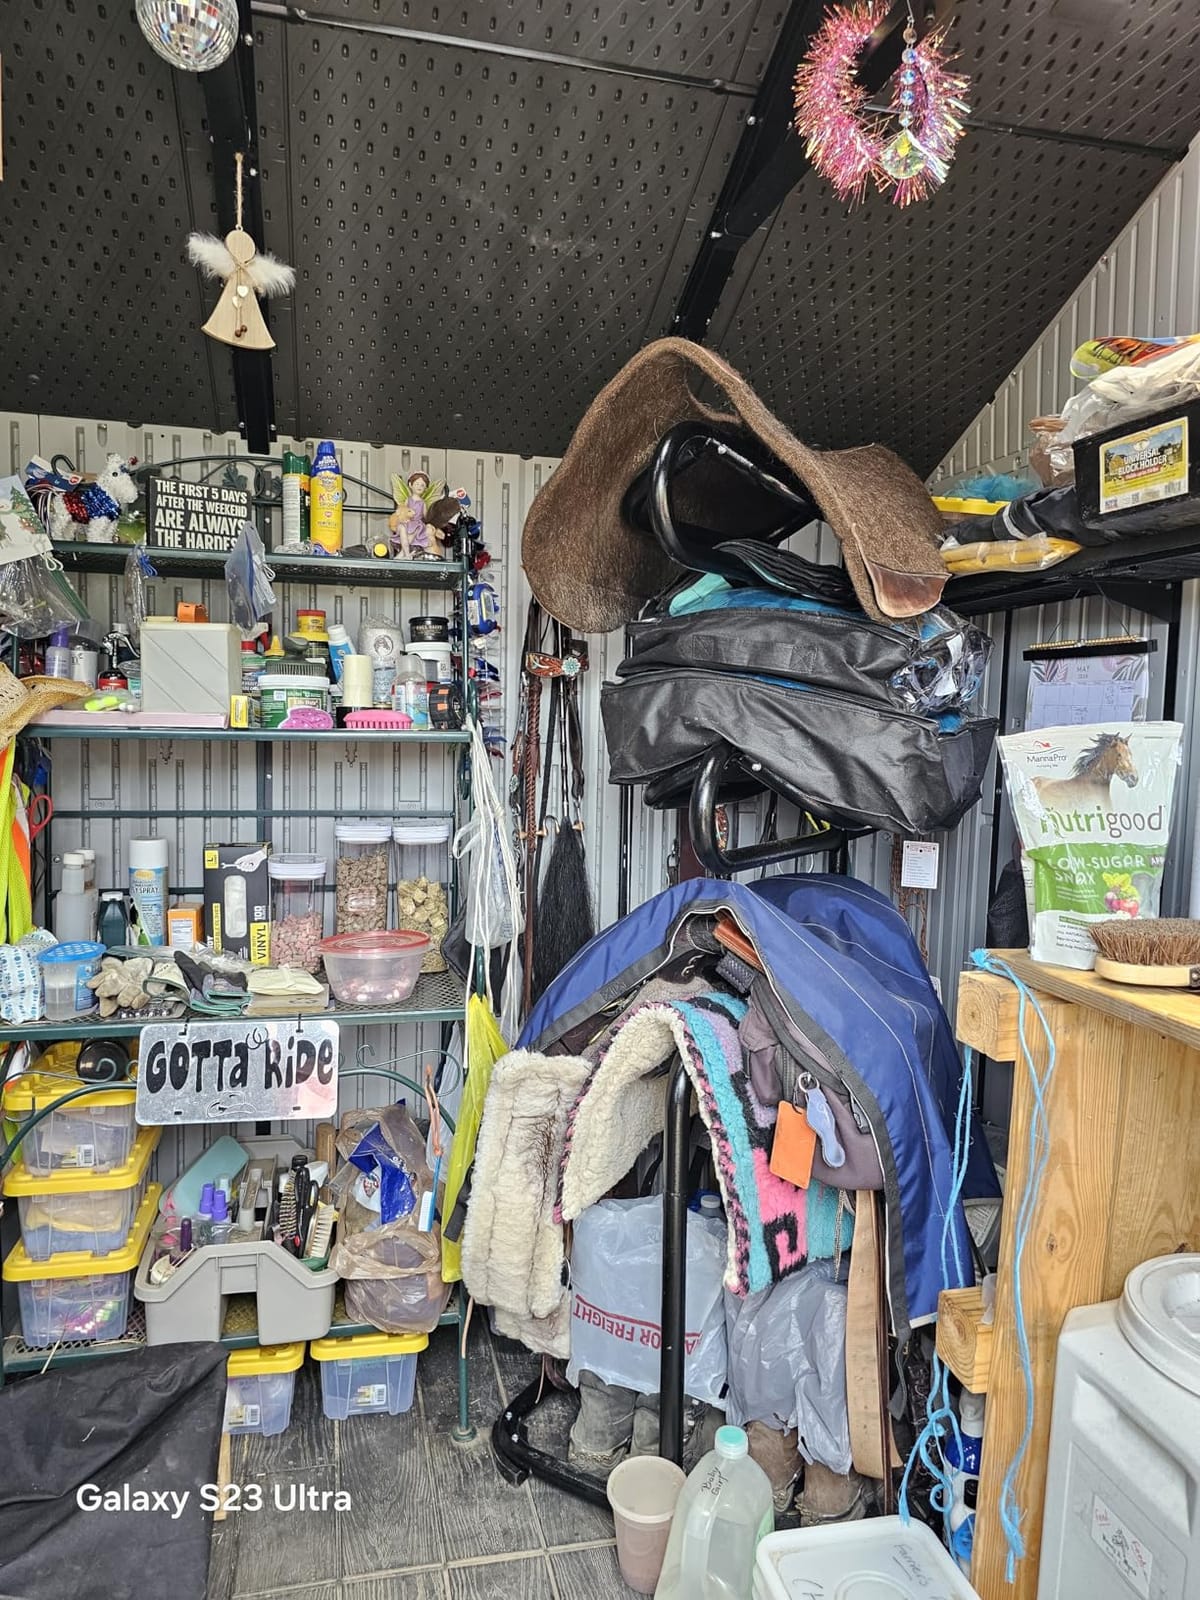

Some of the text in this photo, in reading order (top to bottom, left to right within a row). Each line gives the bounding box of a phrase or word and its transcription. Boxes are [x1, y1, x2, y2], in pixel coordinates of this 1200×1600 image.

[155, 479, 248, 504] THE FIRST 5 DAYS
[156, 494, 248, 518] AFTER THE WEEKEND
[155, 508, 246, 536] ARE ALWAYS
[154, 528, 183, 548] THE
[1040, 805, 1163, 839] nutrigood
[1047, 854, 1146, 871] LOW-SUGAR
[254, 905, 262, 921] 100
[257, 924, 267, 960] VINYL
[573, 1302, 635, 1342] FREIGHT
